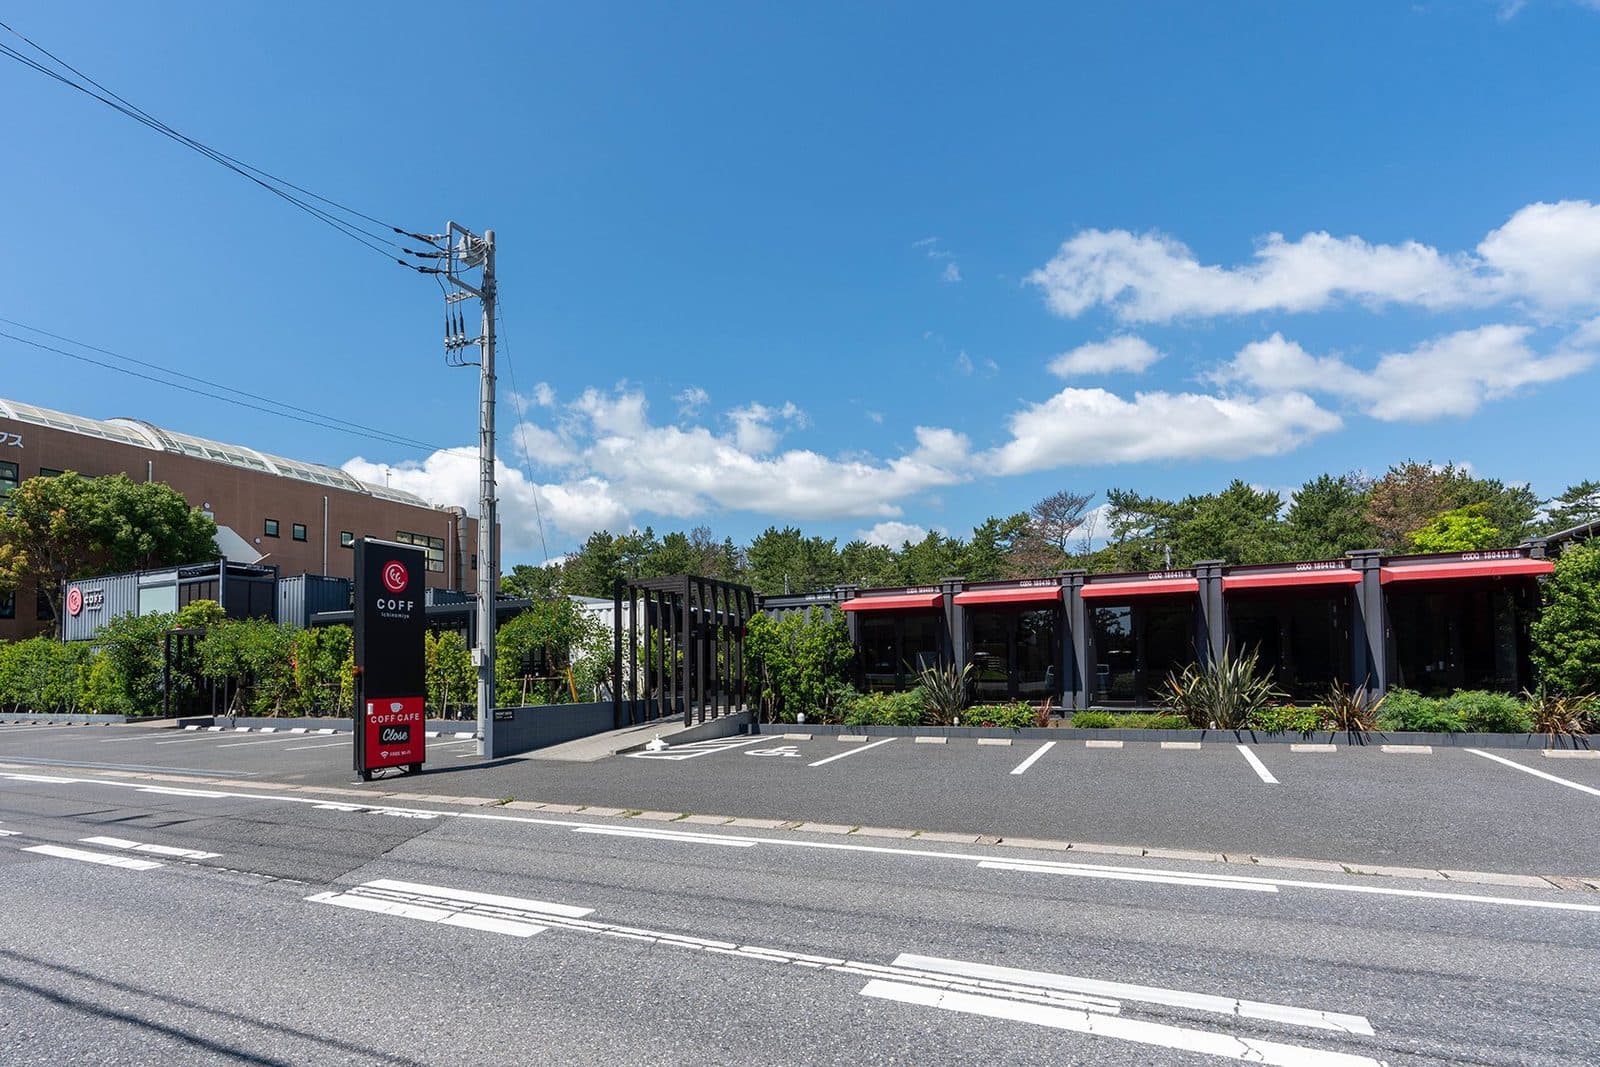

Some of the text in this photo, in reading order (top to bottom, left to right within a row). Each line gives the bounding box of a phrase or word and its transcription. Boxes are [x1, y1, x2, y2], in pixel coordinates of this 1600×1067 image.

[84, 594, 103, 604] COFF
[376, 598, 414, 611] COFF
[370, 713, 420, 724] COFF CAFE
[382, 728, 408, 742] Close
